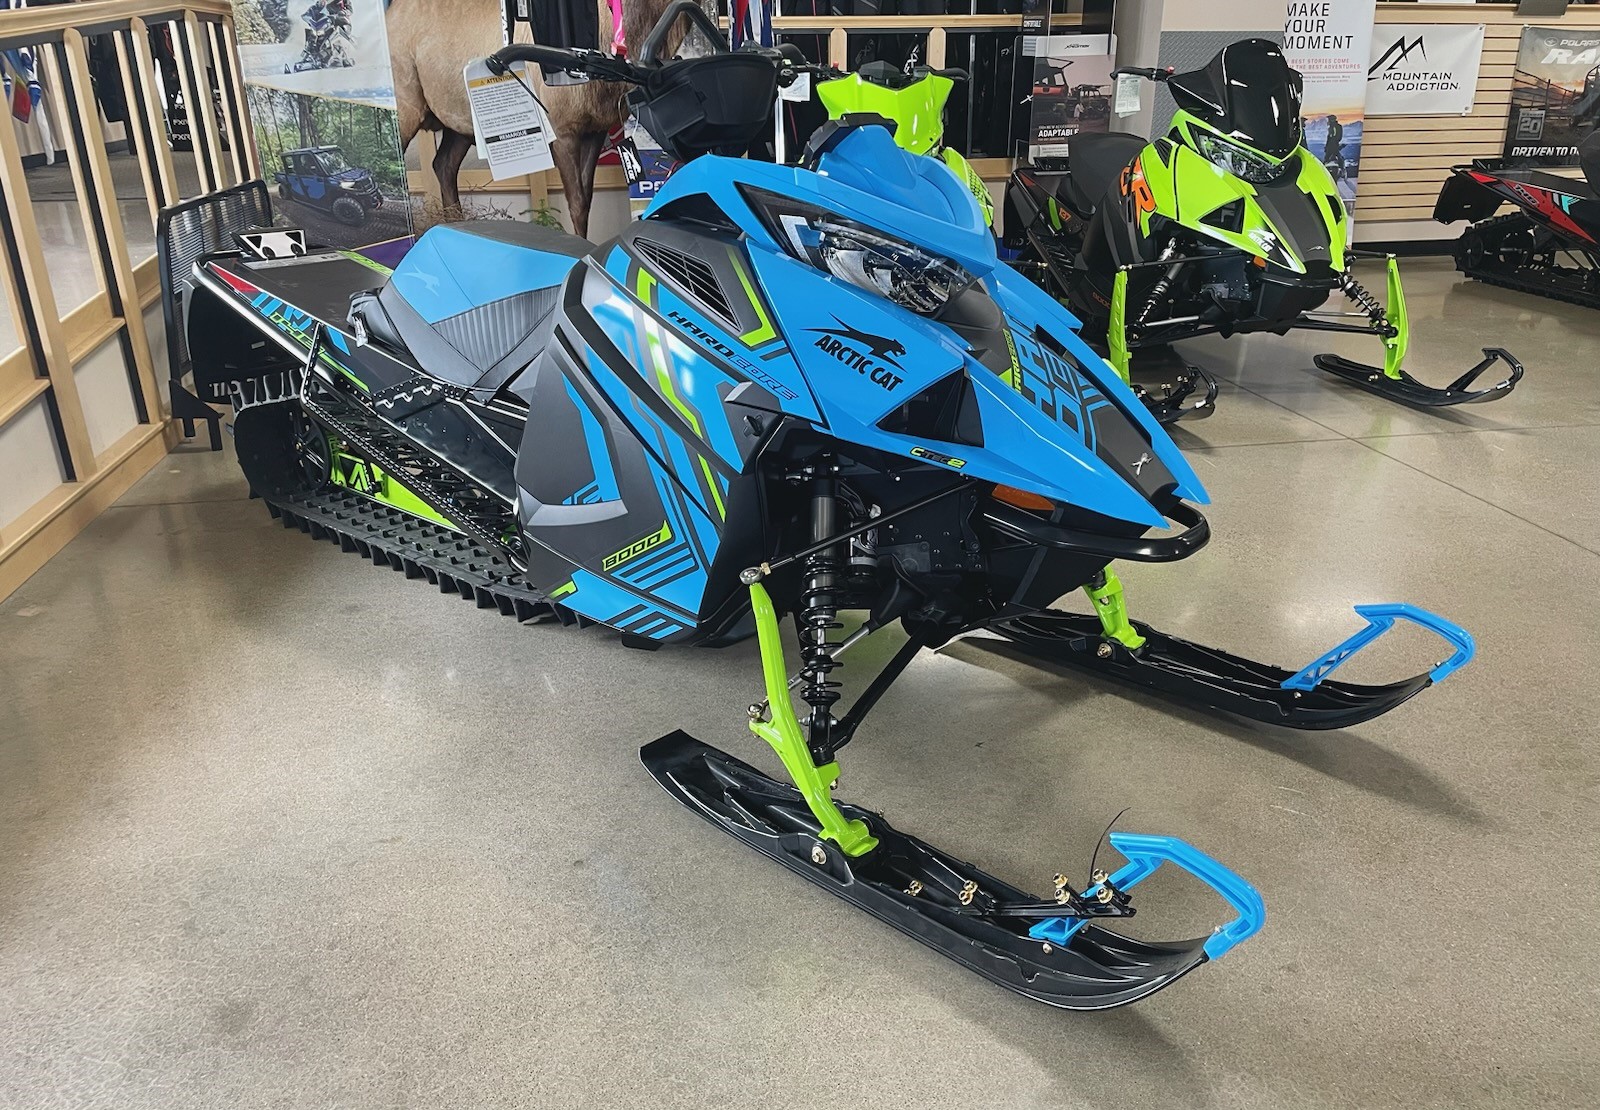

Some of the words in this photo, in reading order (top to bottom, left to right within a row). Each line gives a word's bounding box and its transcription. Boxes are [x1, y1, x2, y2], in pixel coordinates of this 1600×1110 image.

[1287, 3, 1330, 16] MAKE
[1285, 20, 1325, 33] YOUR
[1284, 36, 1353, 49] MOMENT
[1382, 72, 1452, 80] MOUNTAIN
[1386, 82, 1459, 91] ADDICTION
[1511, 146, 1555, 156] DRIVEN
[1556, 146, 1569, 156] TO
[814, 334, 873, 376] ARCTIC
[869, 365, 904, 392] CAT
[605, 531, 662, 568] 8000
